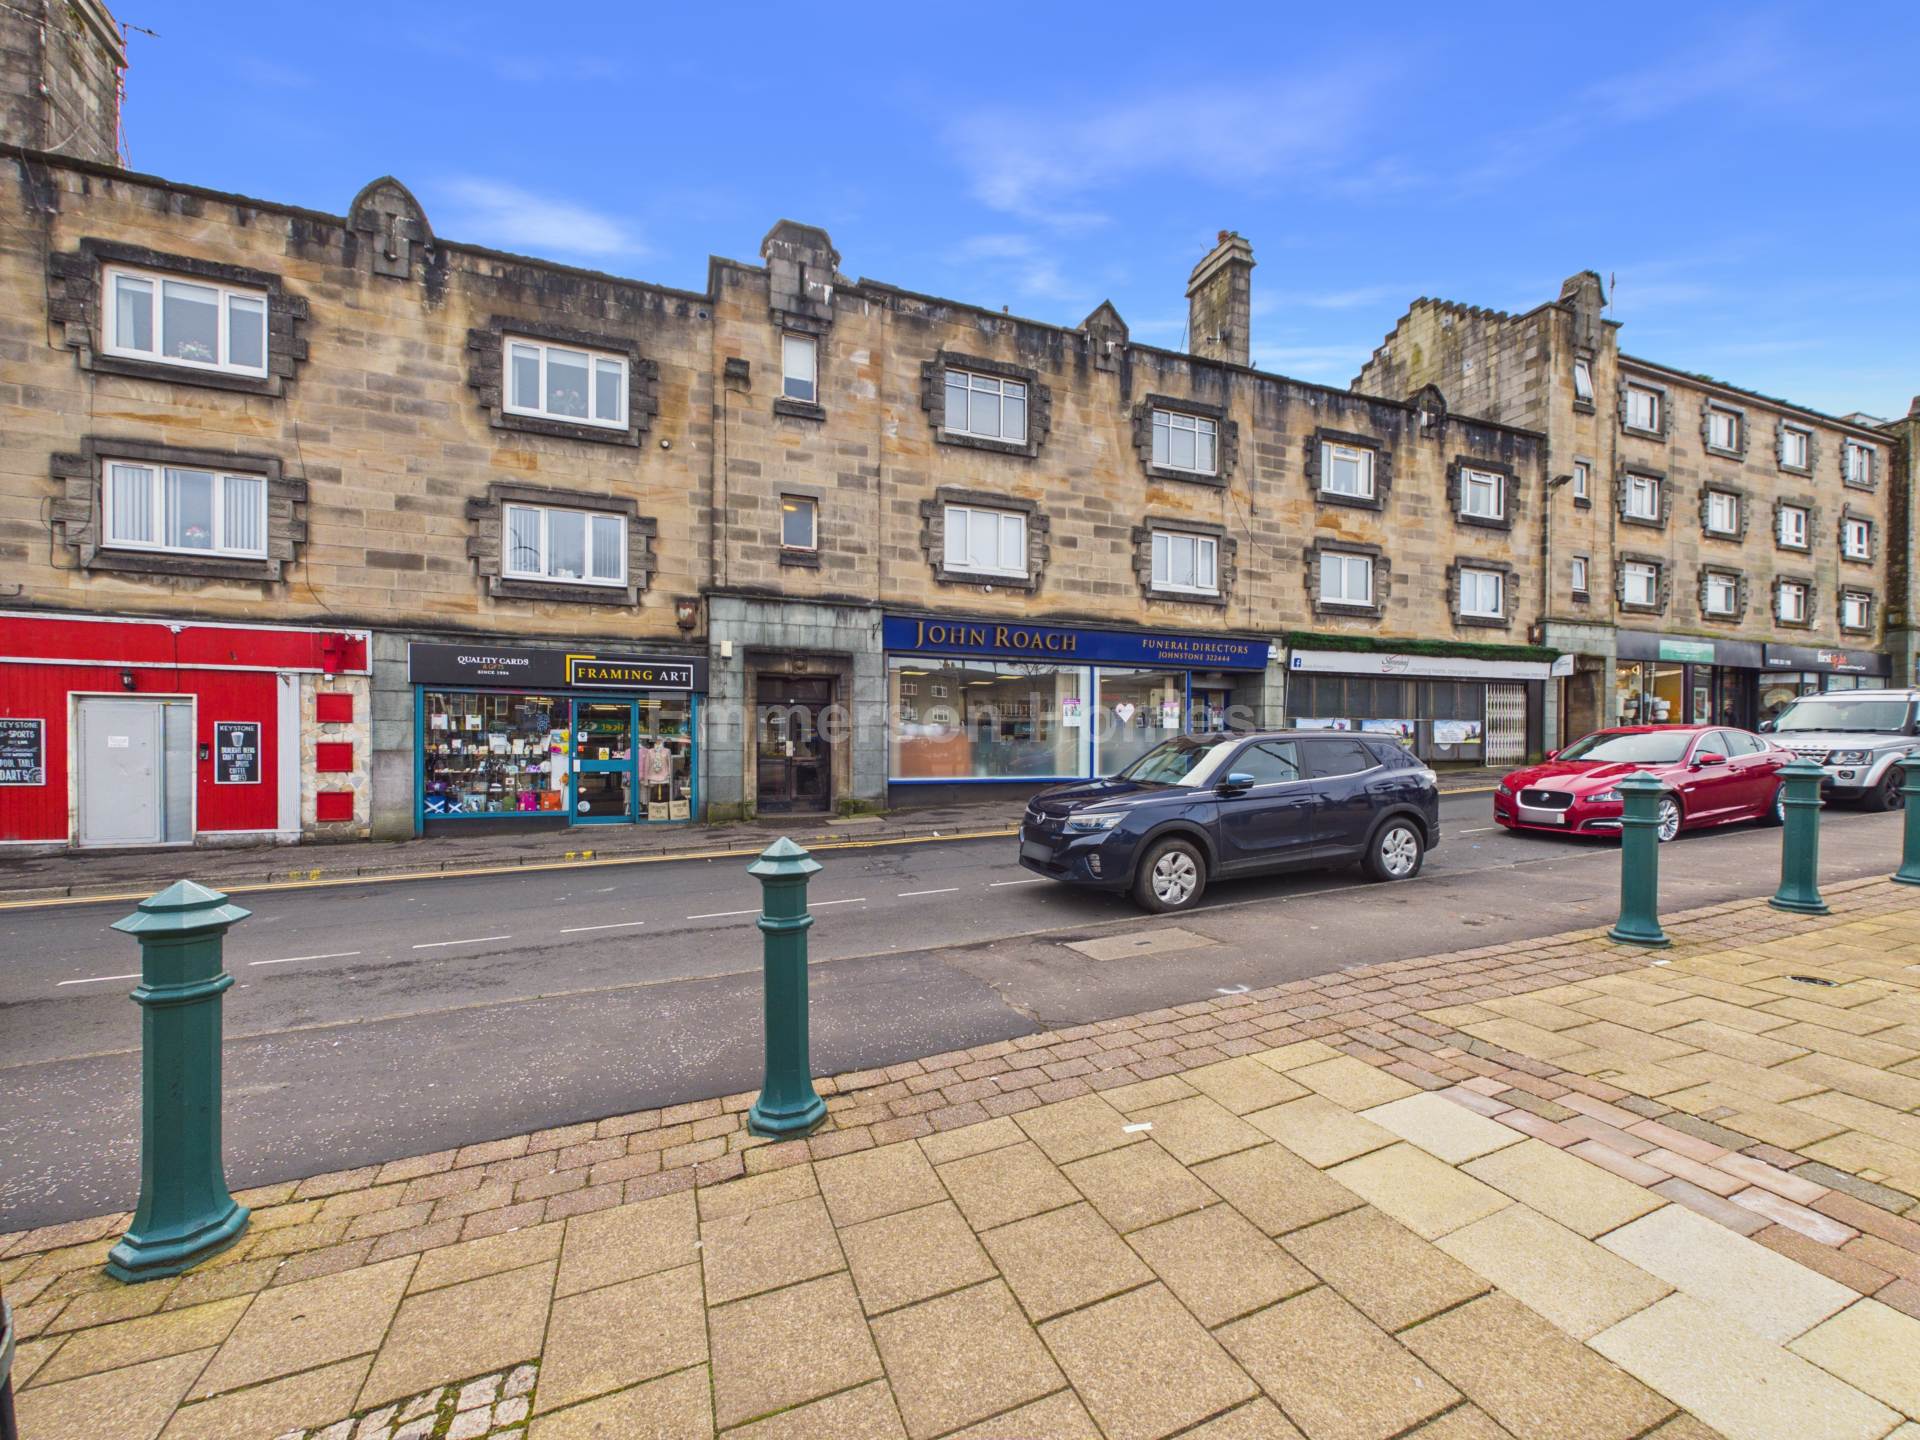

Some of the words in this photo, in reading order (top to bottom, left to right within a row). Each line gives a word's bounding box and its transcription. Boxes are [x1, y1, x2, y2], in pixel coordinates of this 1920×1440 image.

[915, 621, 985, 648] JOHN
[994, 626, 1077, 650] ROACH
[1142, 639, 1188, 650] FUNERAL
[1192, 642, 1249, 654] DIRECTORS
[457, 655, 497, 664] QUALITY
[1158, 650, 1203, 660] JOHNSTONE
[577, 667, 653, 680] FRAMING
[659, 671, 689, 682] ART
[8, 730, 35, 738] SPORTS
[0, 769, 30, 782] DARTS
